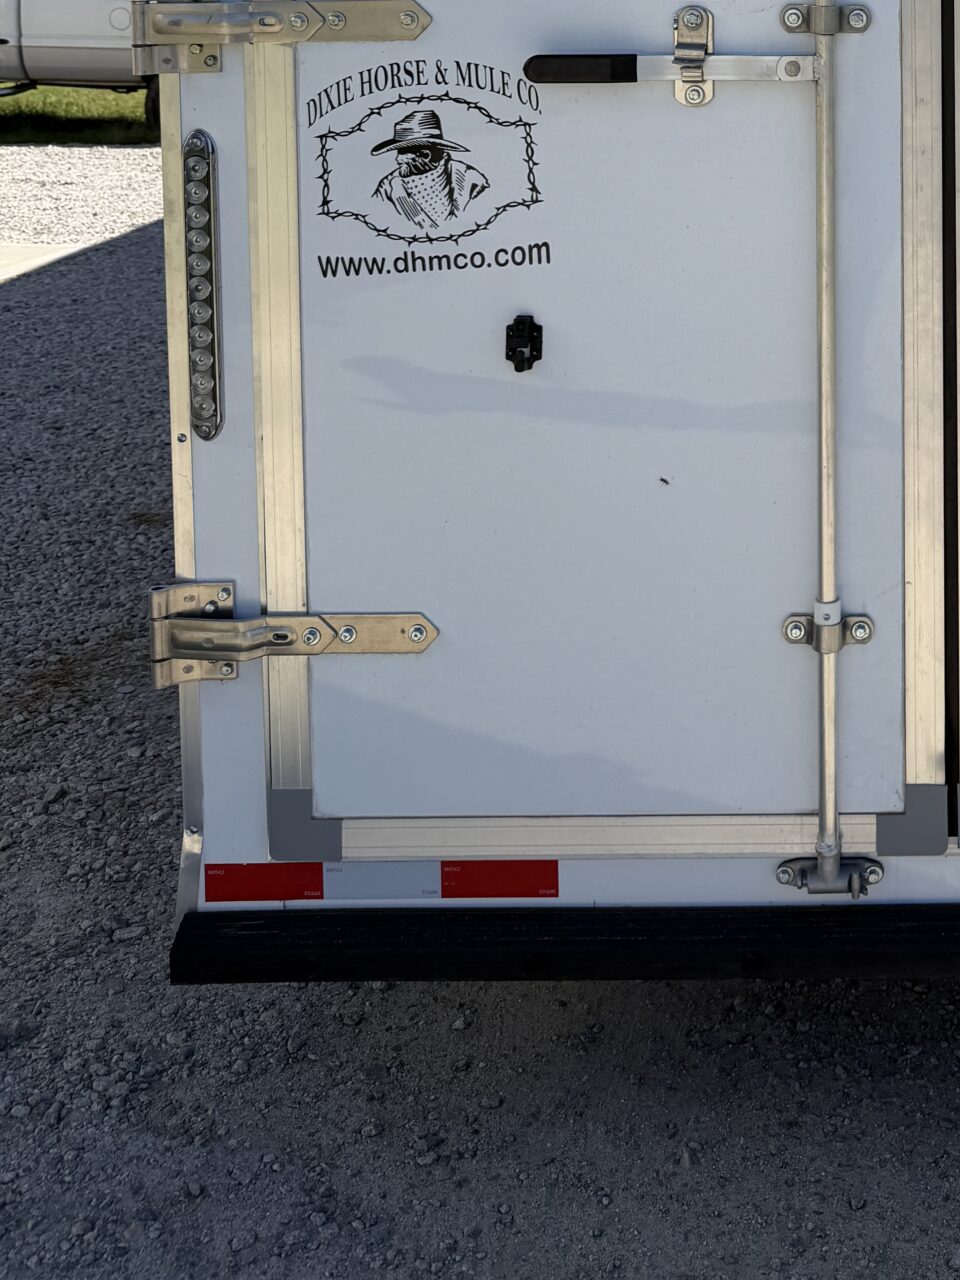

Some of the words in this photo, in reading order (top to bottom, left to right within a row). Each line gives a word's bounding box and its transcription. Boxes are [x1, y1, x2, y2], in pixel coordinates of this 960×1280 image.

[306, 76, 355, 129] DIXIE
[358, 59, 429, 97] HORSE
[434, 59, 449, 86] &
[454, 60, 513, 100] MULE
[516, 78, 543, 116] CO.
[317, 241, 551, 278] www.dhmco.com
